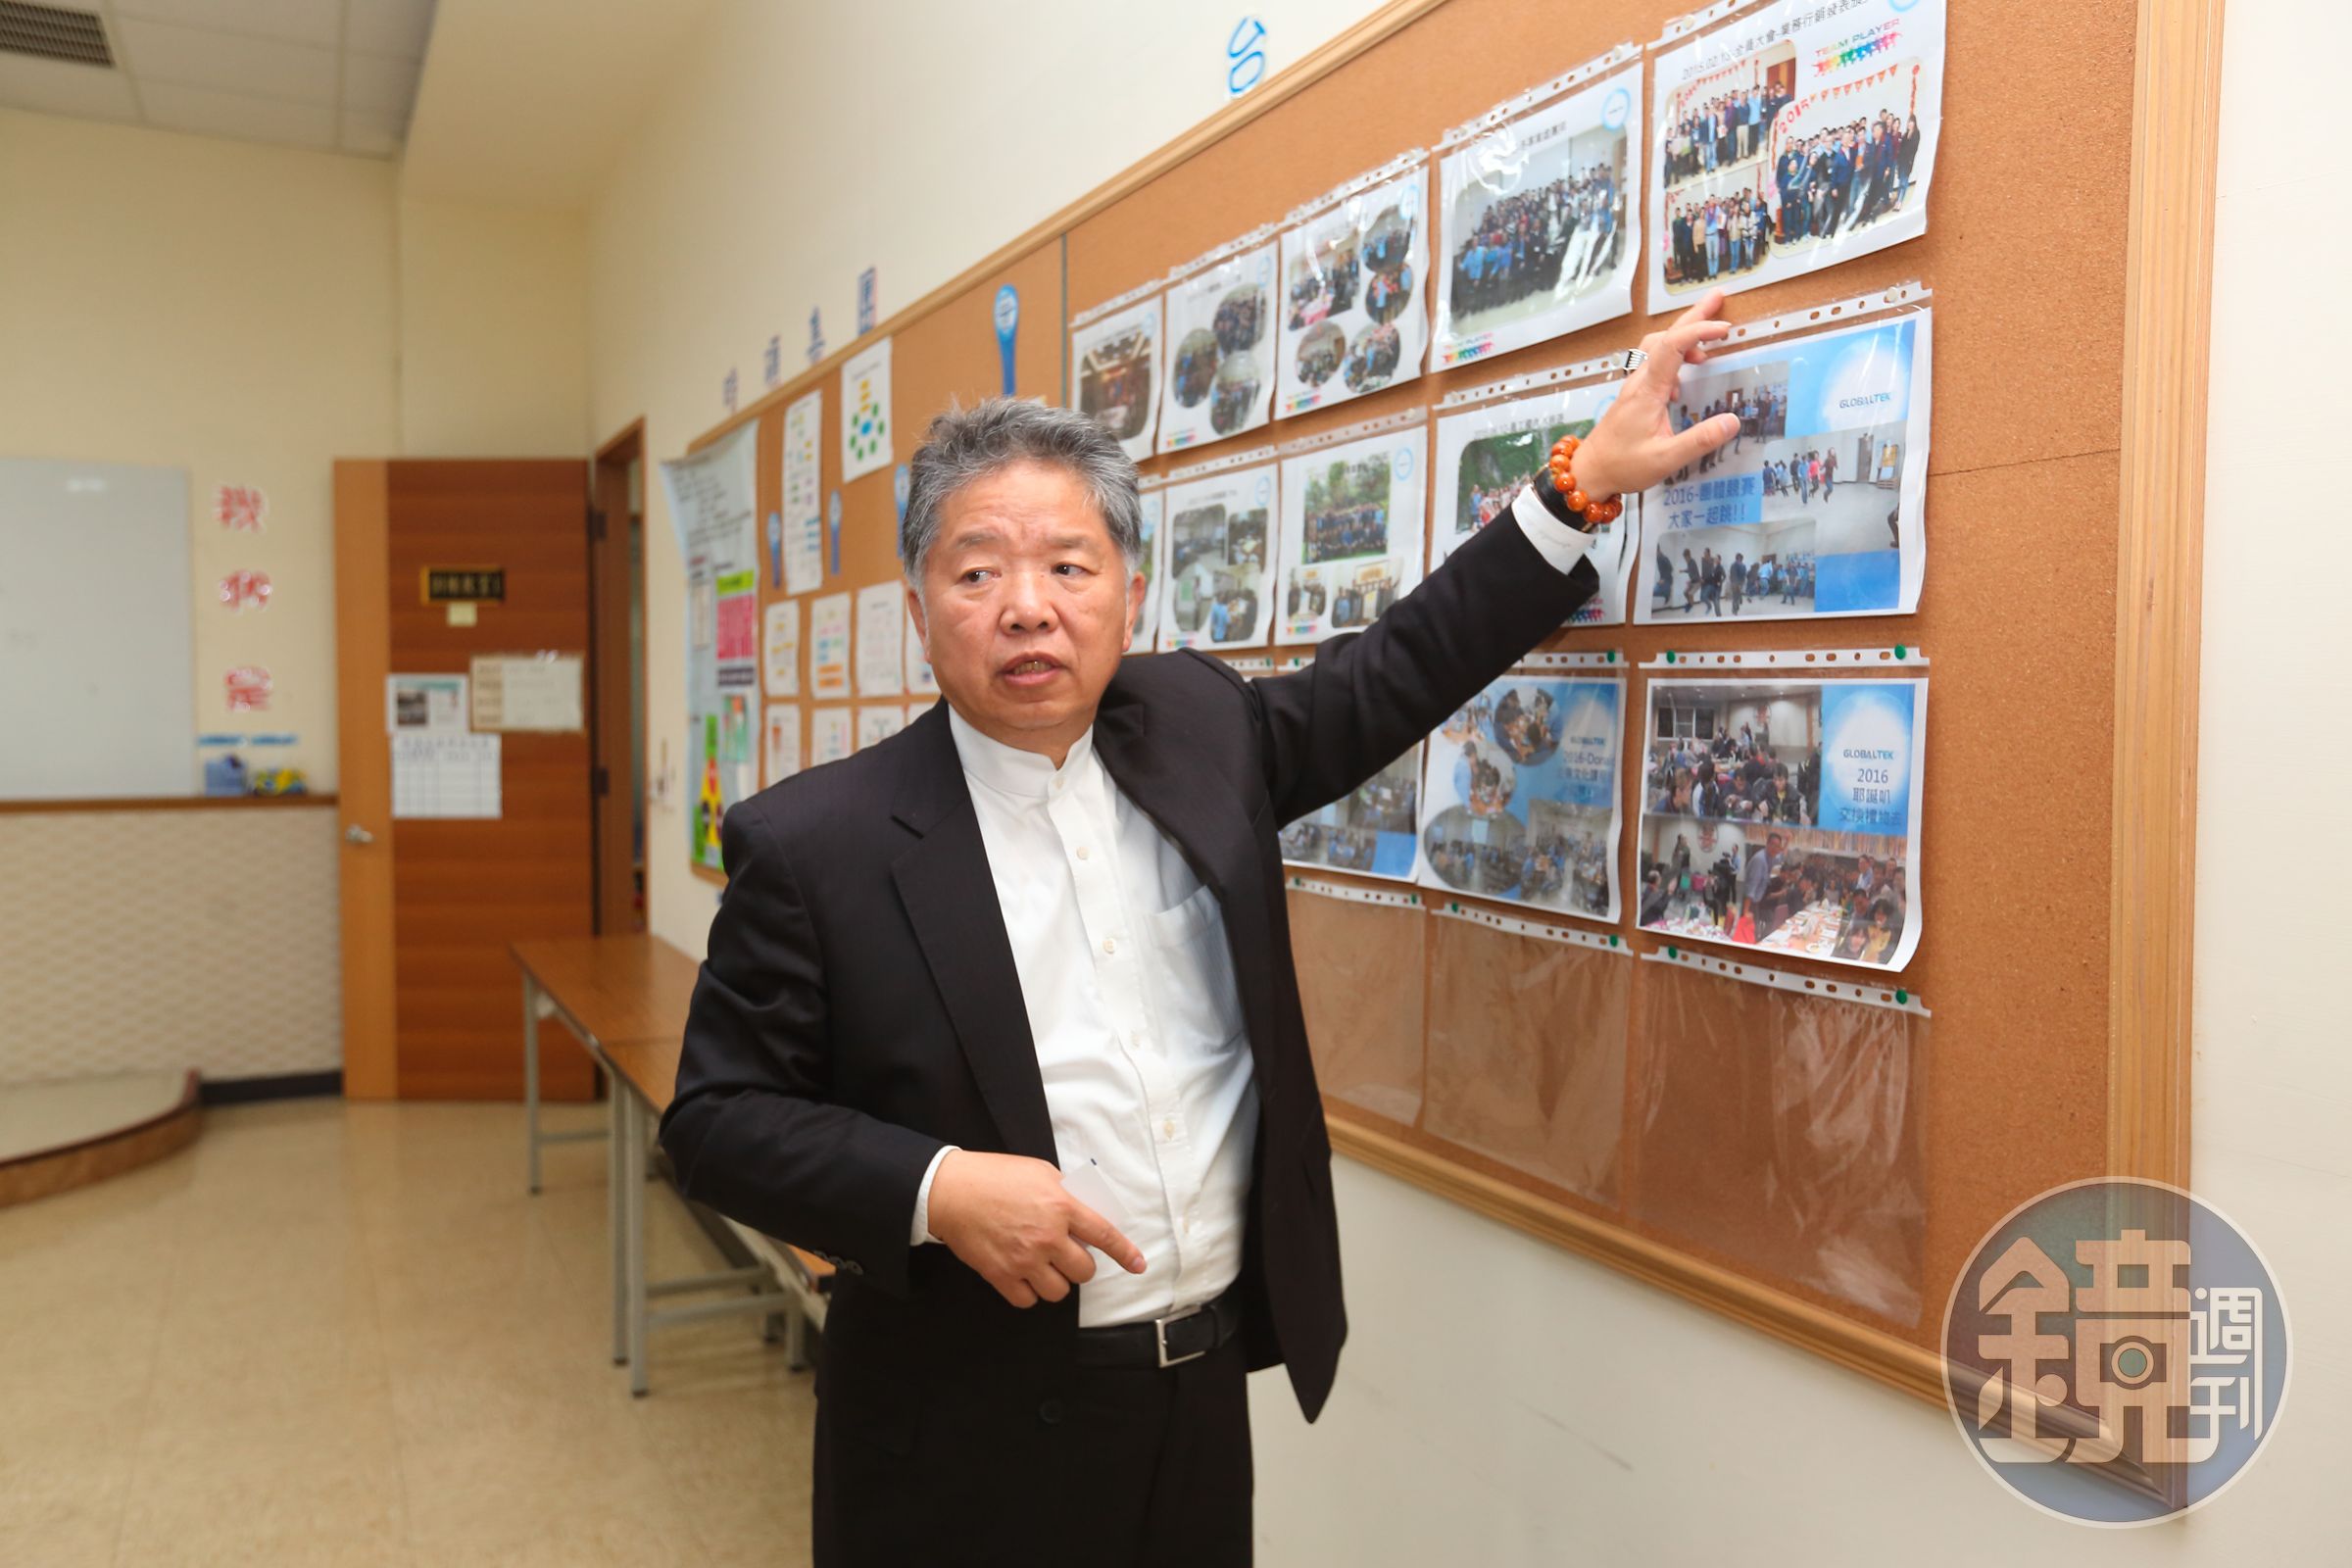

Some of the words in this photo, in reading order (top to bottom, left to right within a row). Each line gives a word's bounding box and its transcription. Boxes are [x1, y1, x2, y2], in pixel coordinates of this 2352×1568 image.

[1852, 18, 1899, 42] PLAYER
[1839, 392, 1890, 409] GLOBALTEK
[1843, 749, 1894, 760] GLOBALTEK
[1857, 768, 1888, 783] 2016
